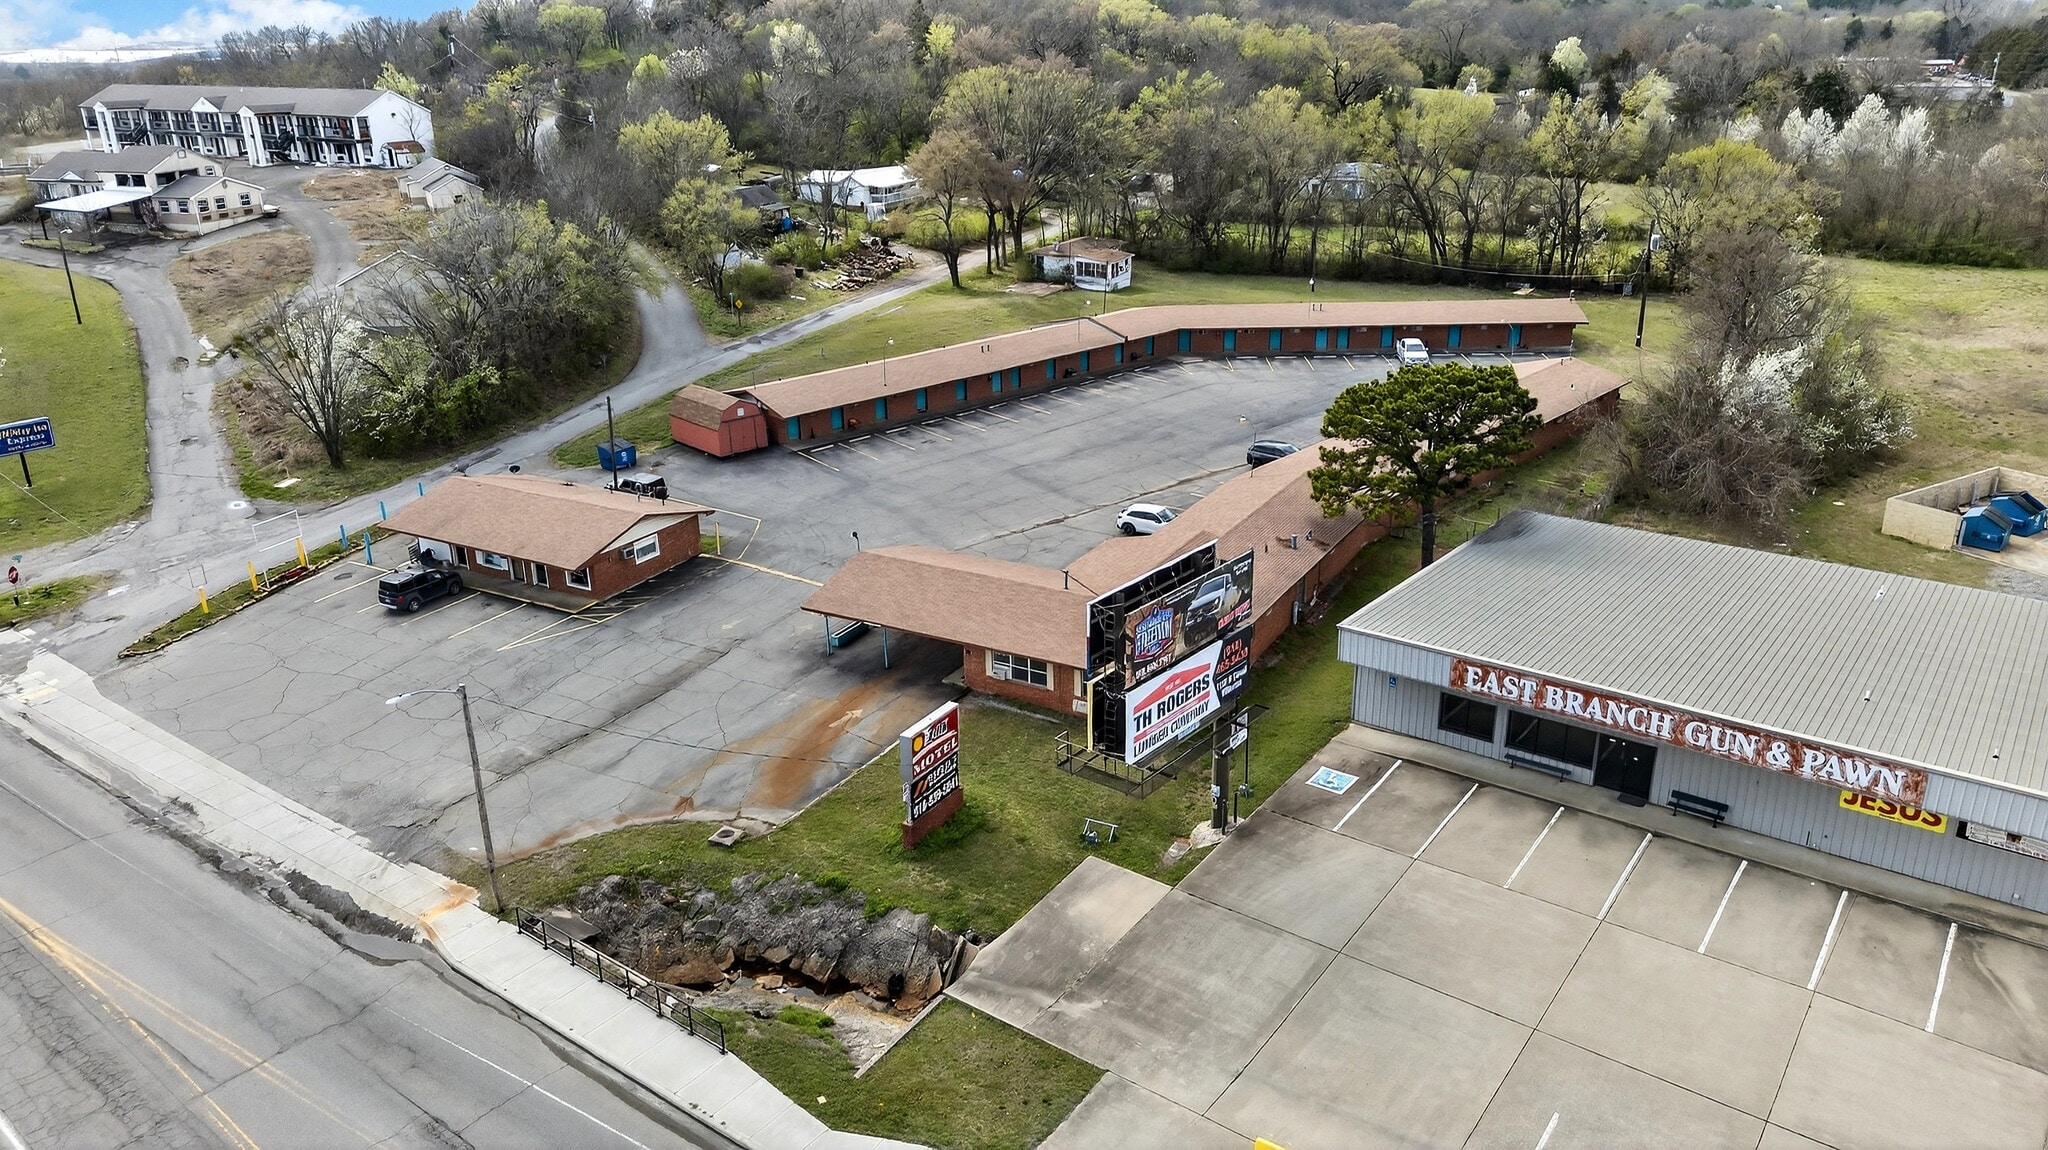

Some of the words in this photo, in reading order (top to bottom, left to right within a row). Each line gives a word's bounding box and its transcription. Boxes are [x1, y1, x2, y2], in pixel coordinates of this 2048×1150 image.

[1133, 708, 1153, 733] TH
[1157, 673, 1210, 720] ROGERS
[1464, 665, 1539, 705] EAST
[1543, 683, 1676, 740] BRANCH
[1684, 720, 1759, 762] GUN
[1764, 740, 1792, 771] &
[1799, 748, 1909, 798] PAWN
[913, 736, 958, 776] MOTEL
